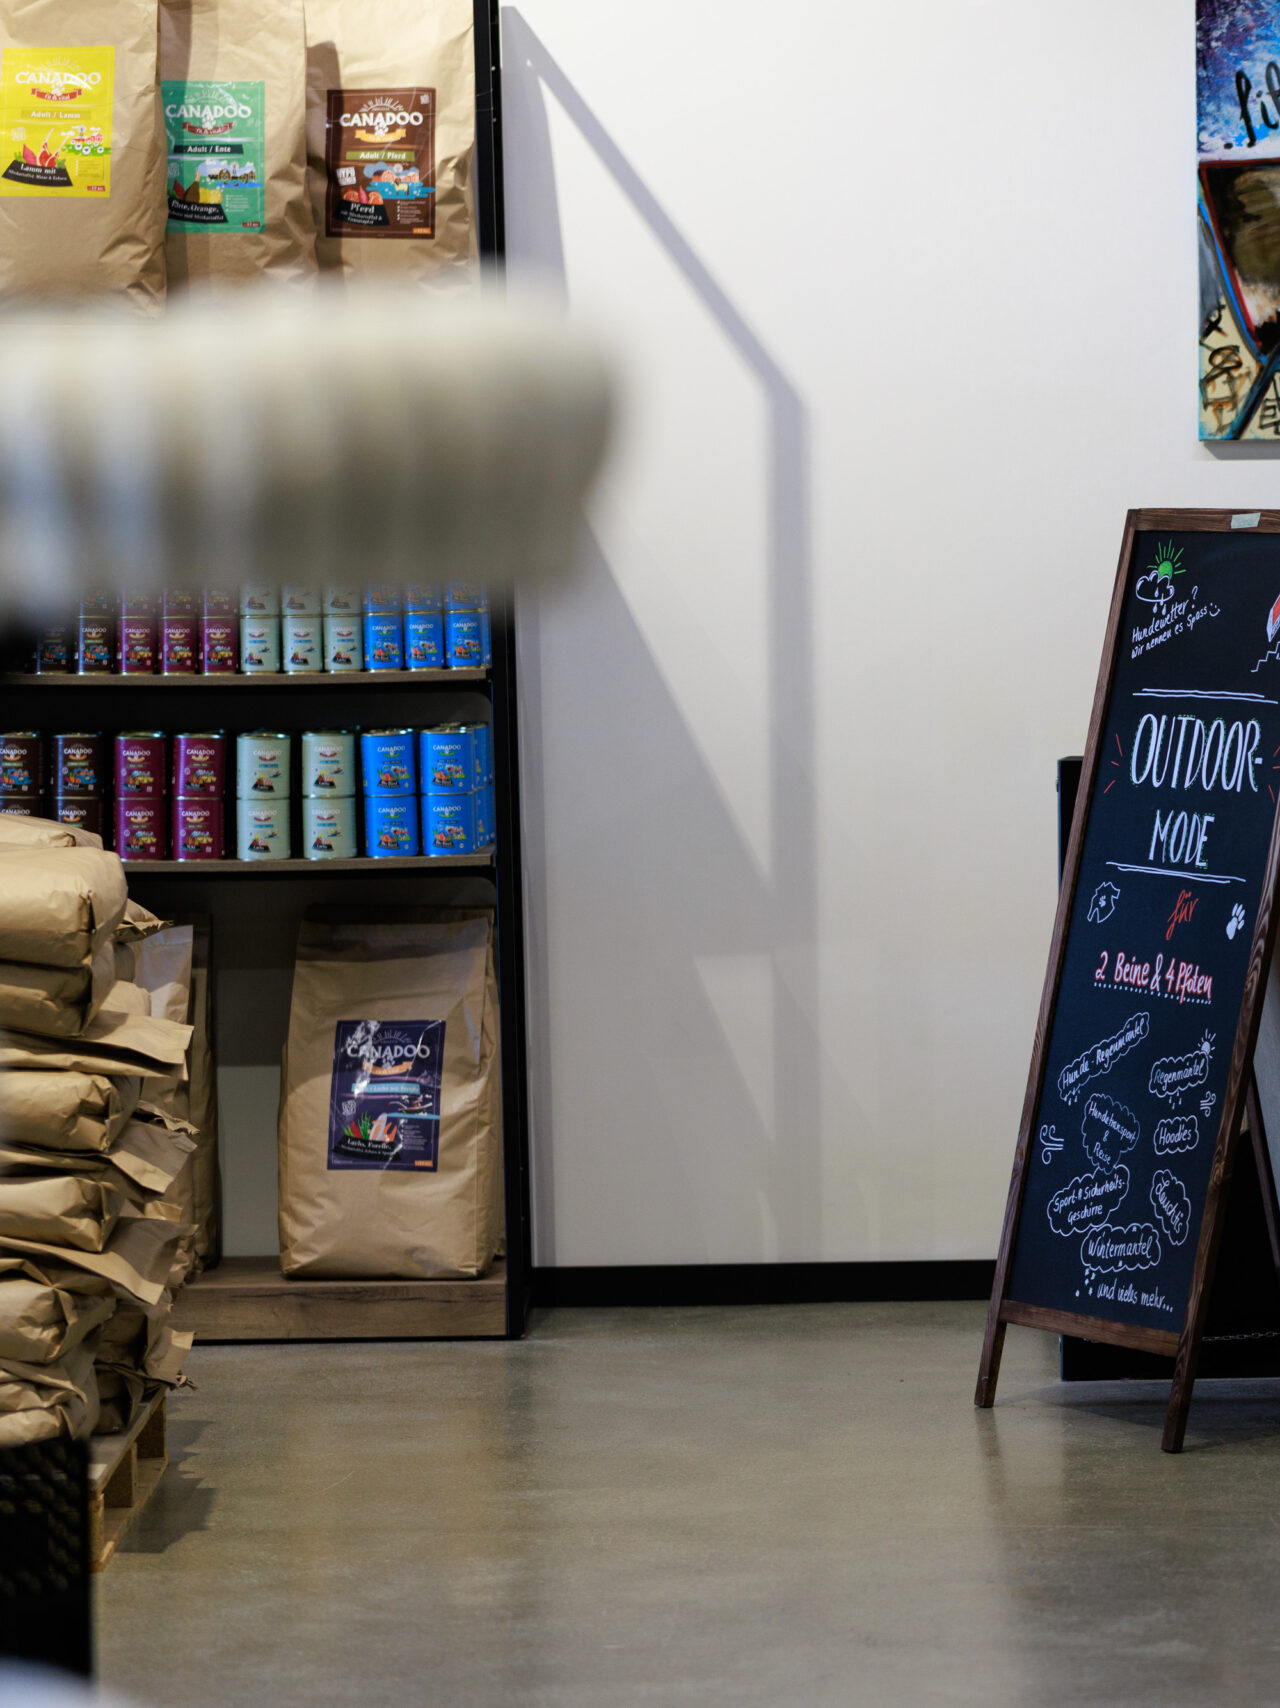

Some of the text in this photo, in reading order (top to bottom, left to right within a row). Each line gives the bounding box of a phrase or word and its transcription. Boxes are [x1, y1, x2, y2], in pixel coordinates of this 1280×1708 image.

[15, 71, 101, 85] CANADOO
[165, 104, 252, 118] CANADOO
[340, 112, 423, 126] CANADOO
[351, 203, 375, 213] Pferd
[1146, 629, 1172, 650] nennen
[1175, 622, 1184, 635] es
[377, 745, 405, 753] CANADOO
[1148, 808, 1215, 869] MODE
[1165, 889, 1199, 941] für
[1095, 951, 1213, 1004] 2 Beine & 4 Pfoten
[1088, 1101, 1136, 1144] Hundetransport
[1159, 1126, 1192, 1146] Hoodies
[1093, 1141, 1112, 1165] Reise
[1097, 1278, 1117, 1300] und
[1118, 1283, 1138, 1304] vieles
